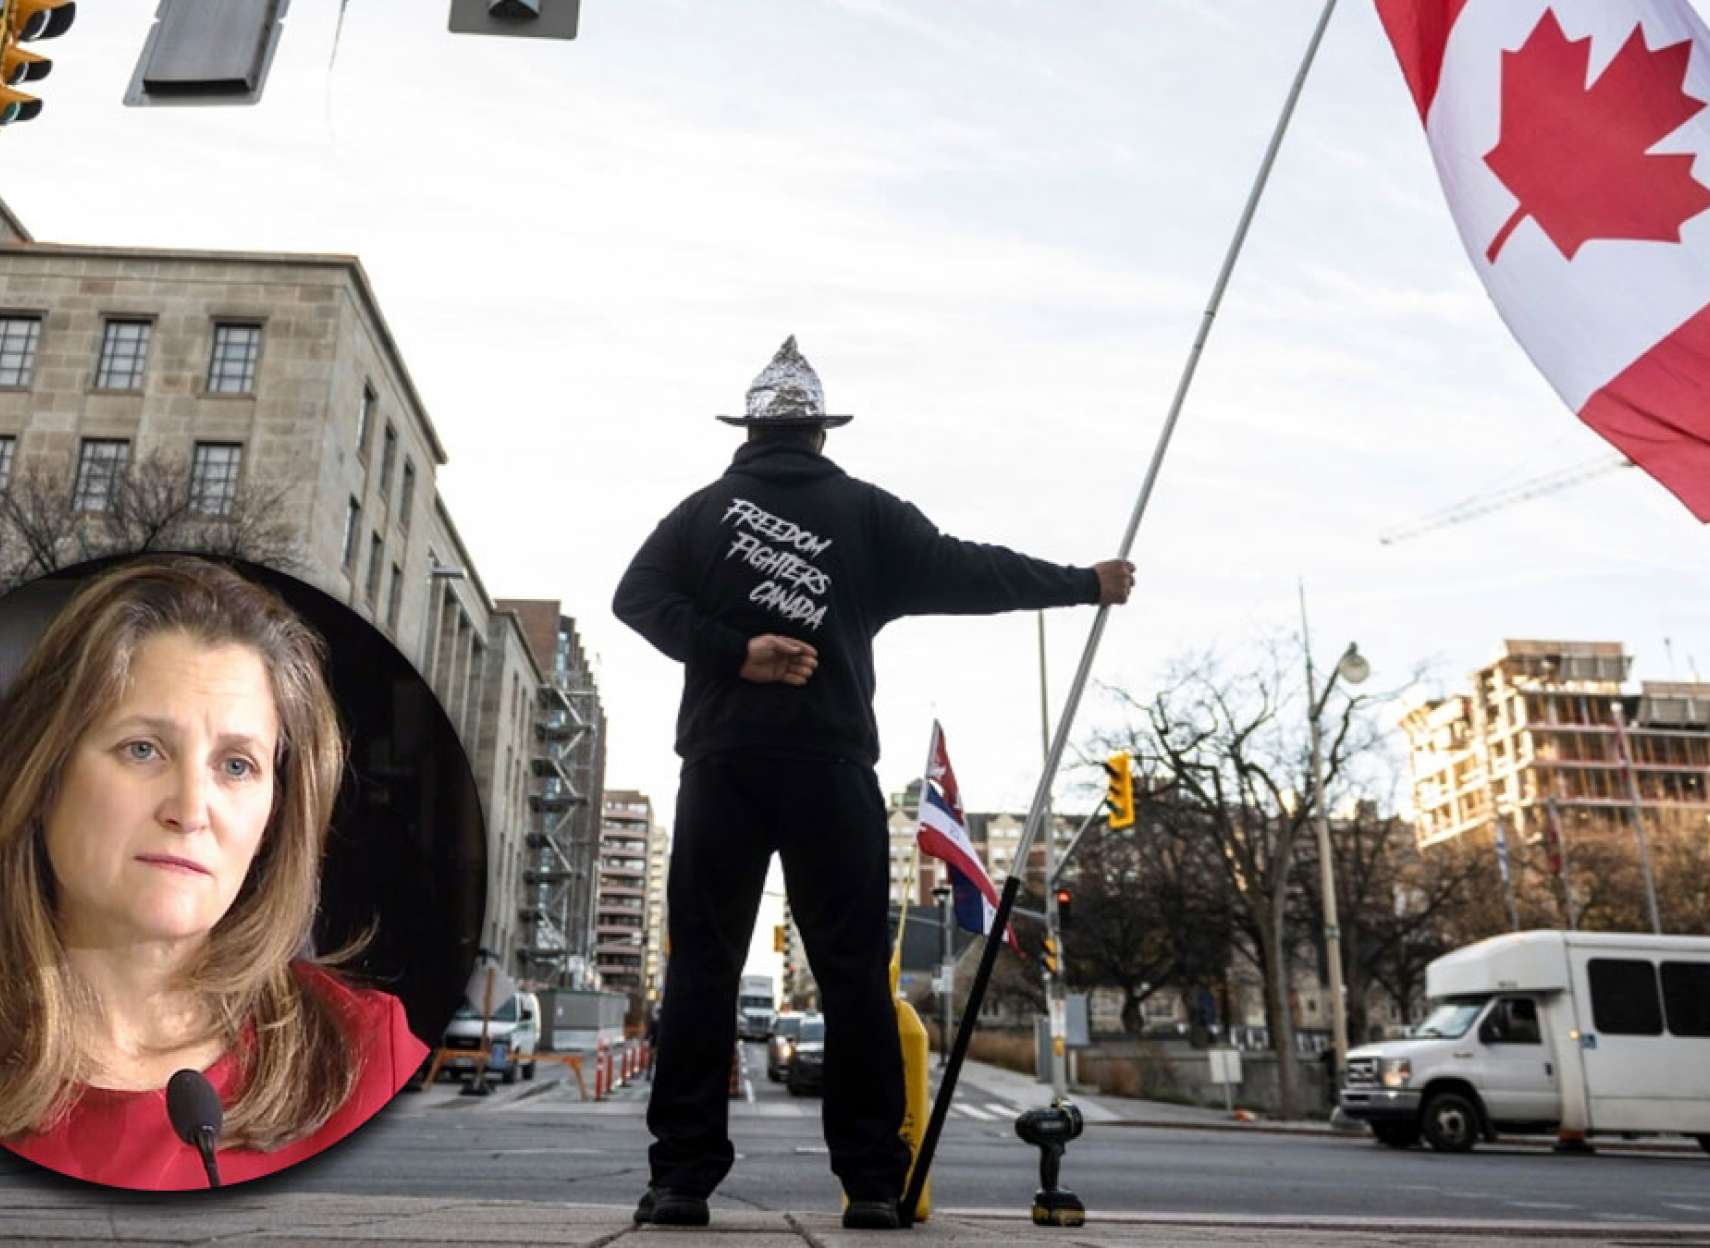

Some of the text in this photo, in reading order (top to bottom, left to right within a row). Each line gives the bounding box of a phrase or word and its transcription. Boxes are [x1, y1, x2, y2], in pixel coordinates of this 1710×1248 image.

[721, 498, 832, 558] FREEDOM
[725, 531, 832, 595] FIGHTERS
[750, 580, 828, 631] CANADA
